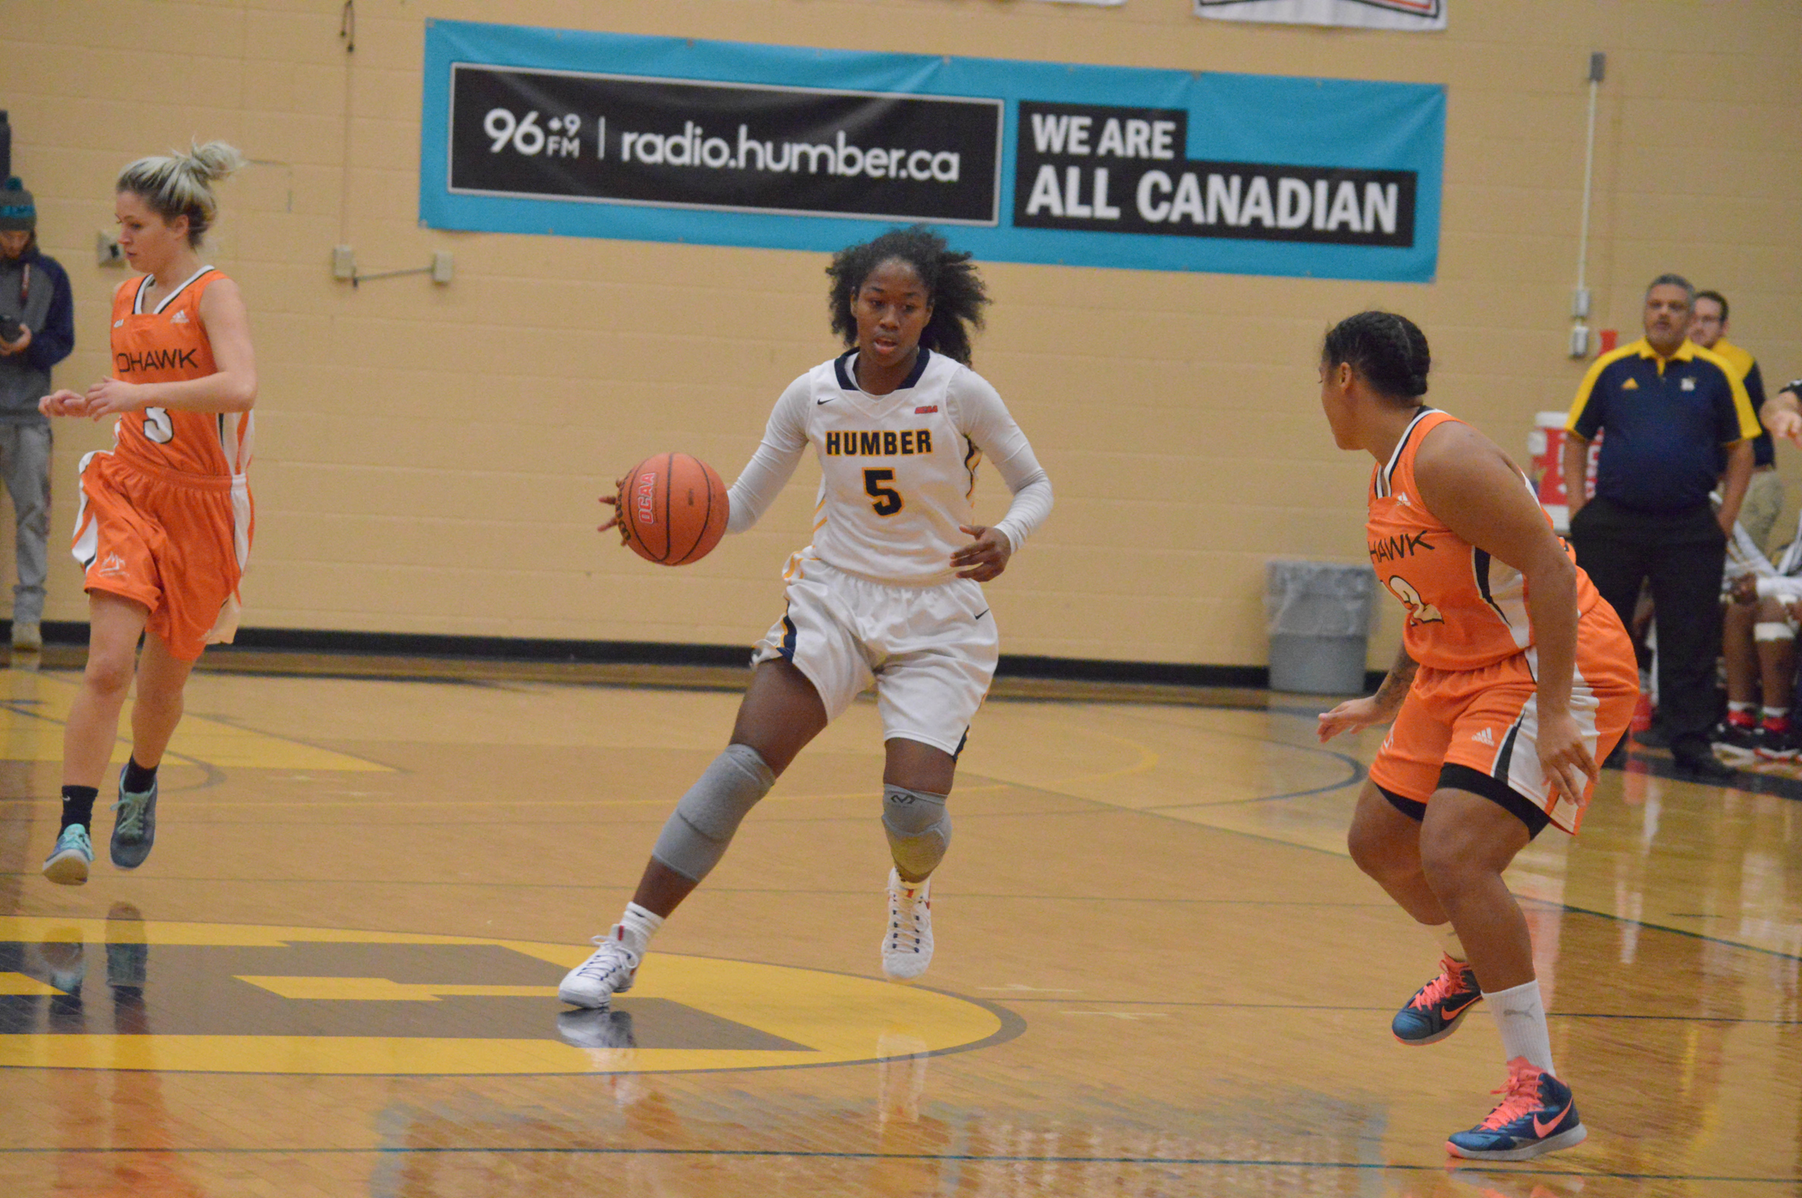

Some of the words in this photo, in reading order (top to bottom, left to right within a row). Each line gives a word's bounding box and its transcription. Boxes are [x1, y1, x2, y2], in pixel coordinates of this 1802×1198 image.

[546, 136, 581, 159] FM
[620, 120, 961, 182] radio.humber.ca
[1031, 113, 1093, 154] WE
[1096, 118, 1176, 160] ARE
[1026, 164, 1121, 219] ALL
[1136, 170, 1399, 235] CANADIAN
[116, 348, 199, 373] OHAWK
[825, 428, 933, 456] HUMBER
[638, 472, 656, 525] OCAA
[862, 467, 905, 518] 5
[1368, 530, 1435, 564] HAWK
